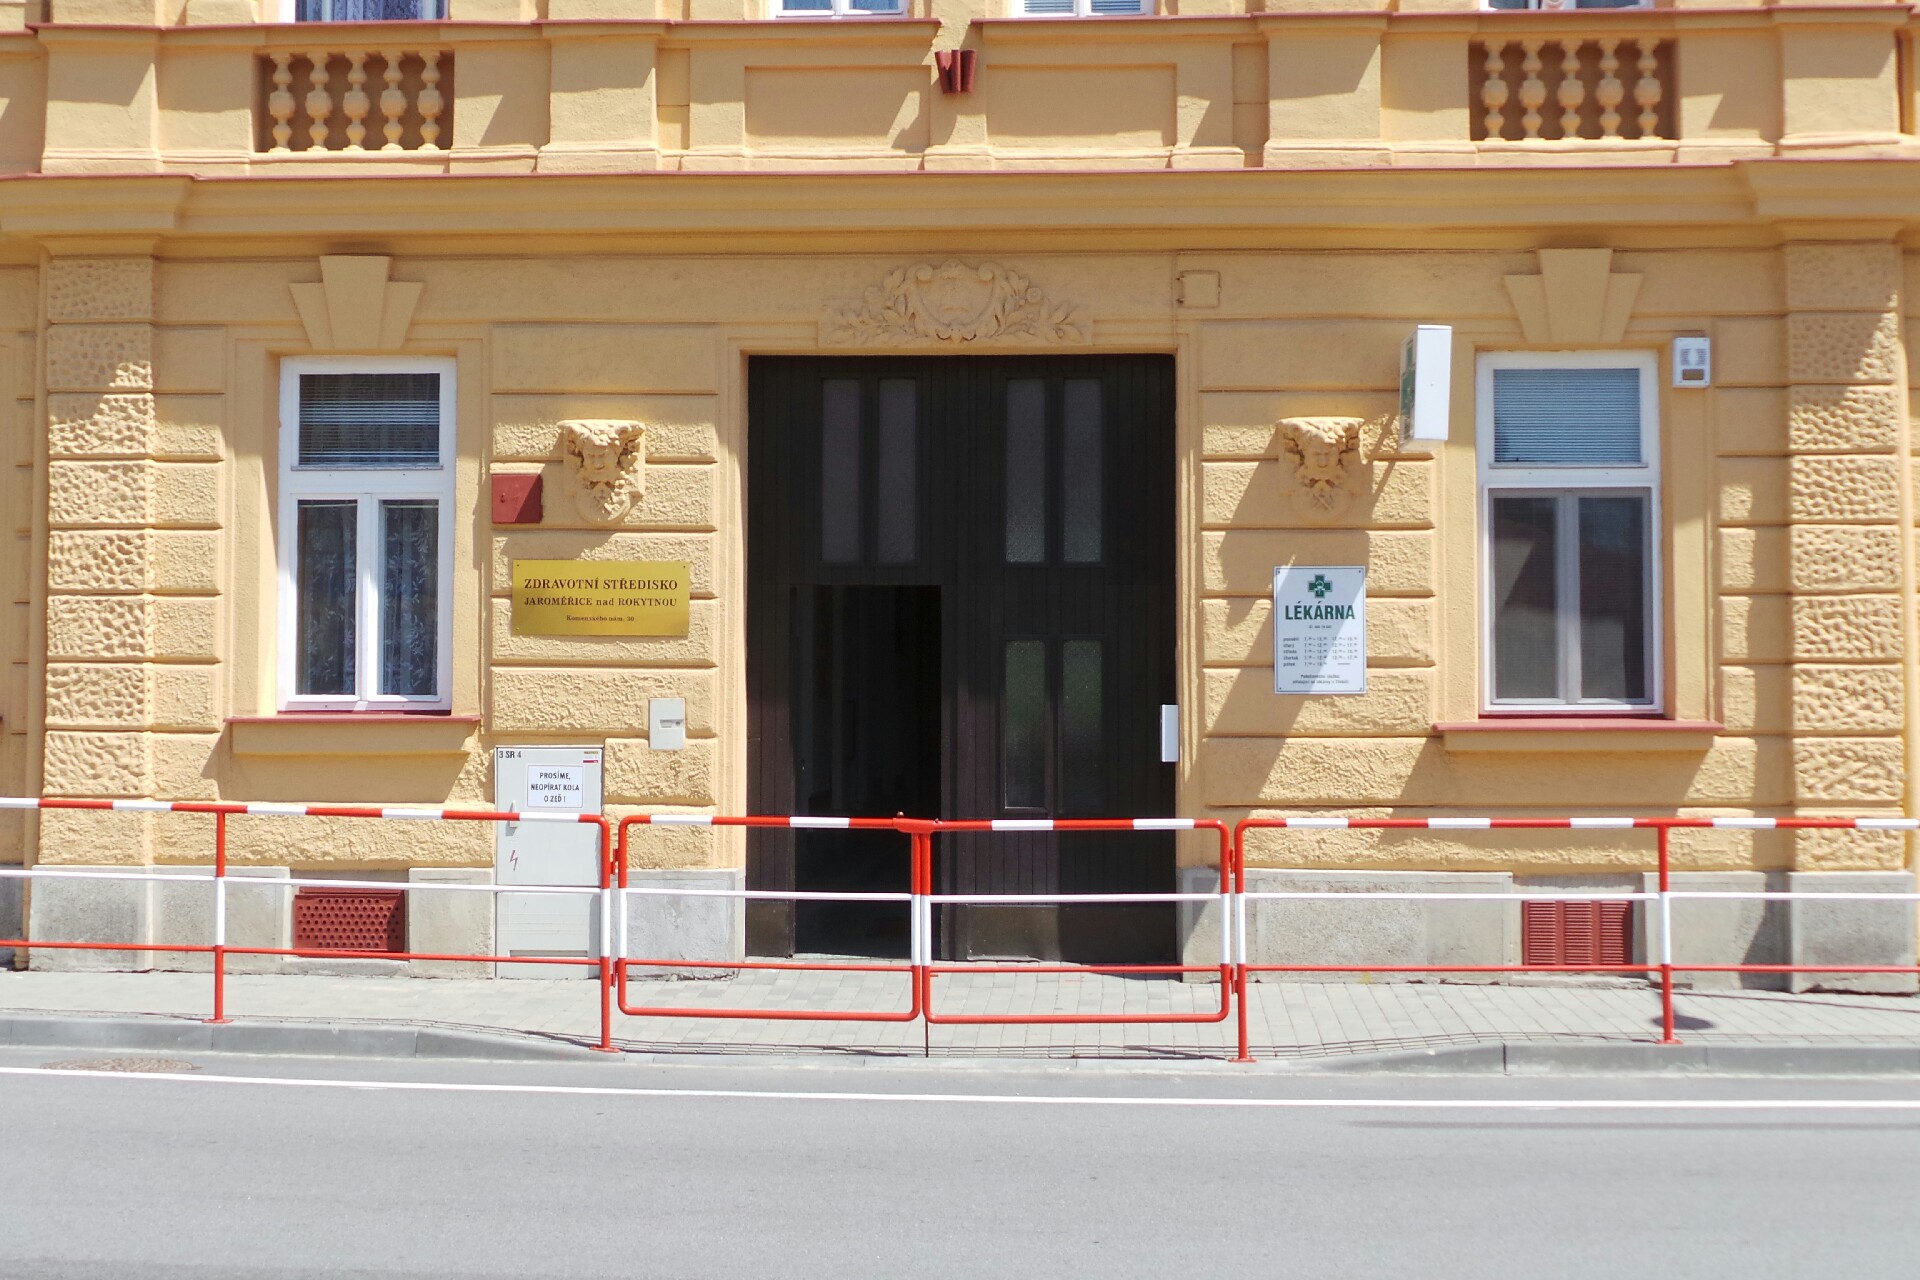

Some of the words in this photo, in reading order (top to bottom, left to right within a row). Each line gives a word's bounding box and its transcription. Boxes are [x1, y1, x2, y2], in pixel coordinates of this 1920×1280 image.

[524, 577, 599, 589] ZDRAVOTNÍ
[603, 578, 678, 590] STŘEDISKO
[524, 596, 593, 606] JAROMĚŘICE
[596, 598, 614, 606] nad
[618, 598, 677, 607] ROKYTNOU
[1285, 601, 1355, 620] LÉKÁRNA
[505, 751, 515, 759] SR
[517, 751, 522, 759] 4
[539, 771, 571, 780] PROSÍME,
[530, 783, 561, 791] NEOPÍRAT
[550, 794, 562, 803] ZEĎ
